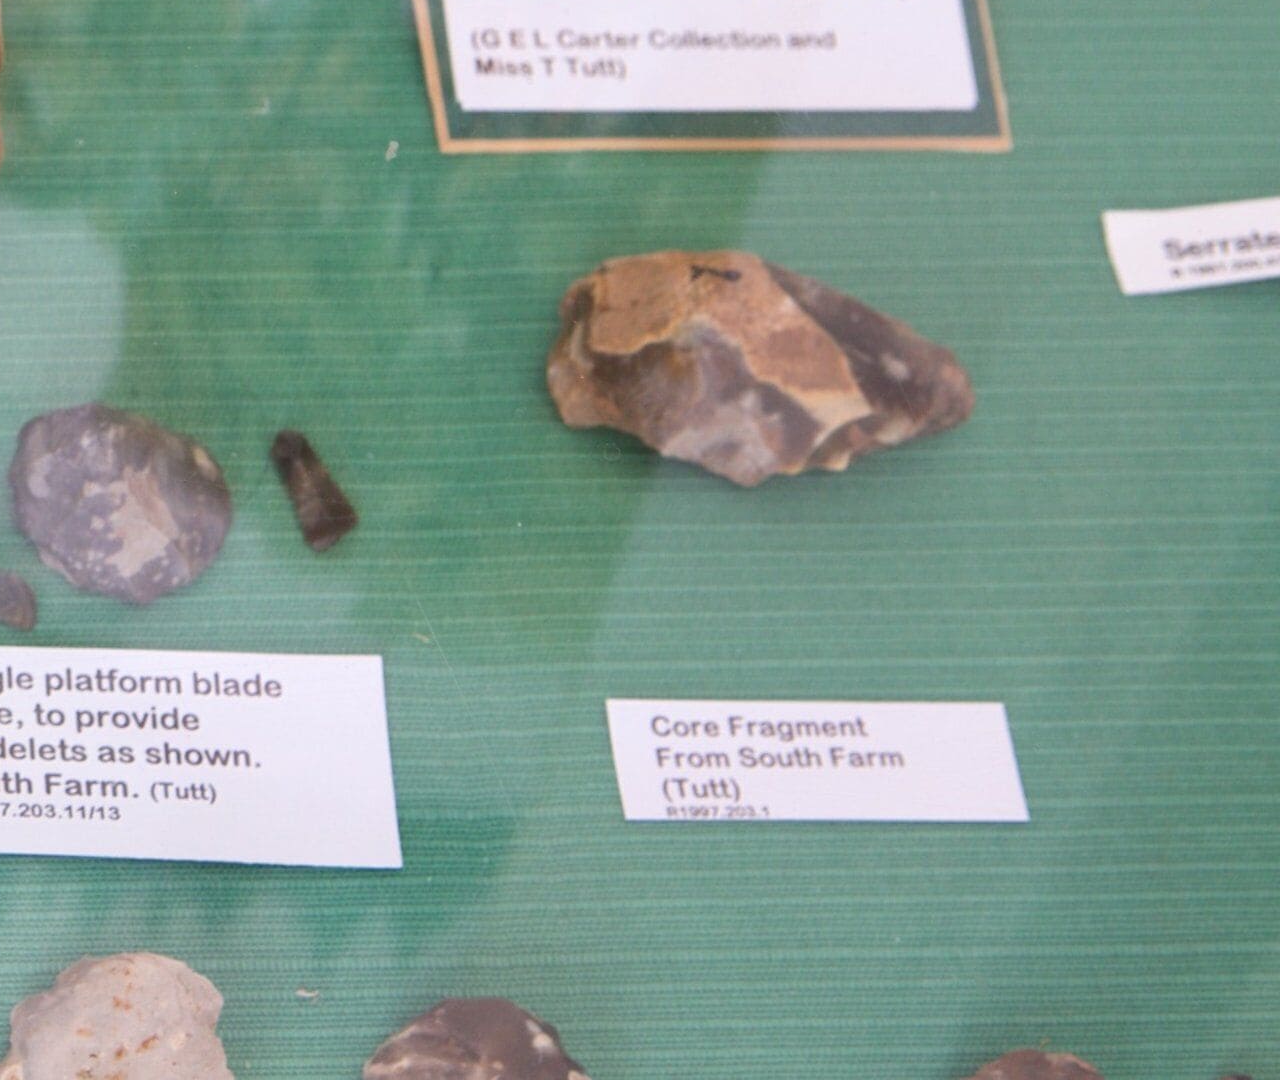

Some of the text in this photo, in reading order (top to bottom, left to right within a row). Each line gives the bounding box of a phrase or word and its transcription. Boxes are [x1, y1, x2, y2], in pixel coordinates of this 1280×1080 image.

[509, 30, 525, 49] E
[533, 30, 548, 49] L
[556, 29, 641, 50] Carter
[648, 30, 780, 50] Collection
[788, 31, 837, 50] and
[475, 58, 627, 80] Miss T Tutt)
[45, 668, 182, 696] platform
[193, 672, 282, 698] blade
[34, 704, 65, 726] to
[76, 707, 199, 733] provide
[651, 715, 868, 742] Core Fragment
[98, 746, 135, 763] as
[146, 742, 260, 767] shown.
[655, 747, 905, 768] From South Farm
[44, 773, 138, 798] Farm.
[150, 782, 216, 804] (Tutt)
[662, 778, 741, 802] (Tutt)
